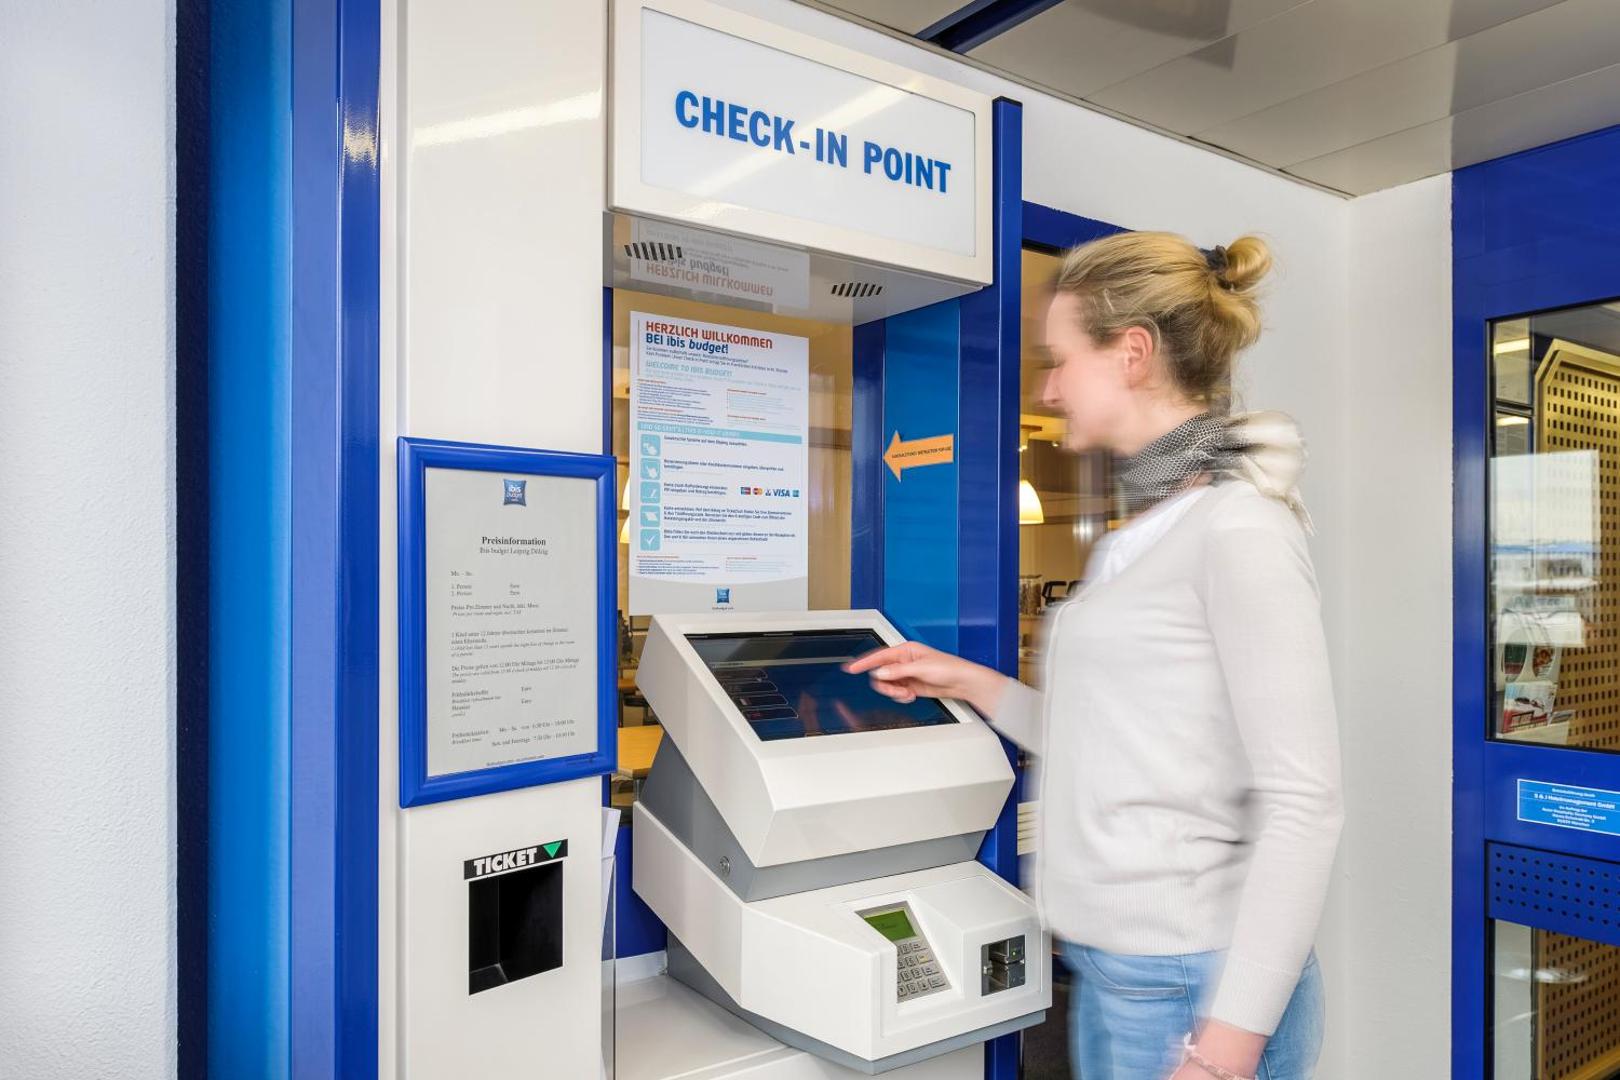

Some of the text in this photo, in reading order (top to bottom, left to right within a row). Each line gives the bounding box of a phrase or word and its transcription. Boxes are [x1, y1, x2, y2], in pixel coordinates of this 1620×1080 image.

[675, 90, 951, 193] CHECK-IN POINT
[646, 321, 773, 349] HERZLICH WILLKOMMEN
[646, 333, 729, 354] BEI ibis budget!
[773, 488, 790, 497] VISA
[481, 536, 546, 546] Preisinformation
[473, 847, 537, 876] TICKET
